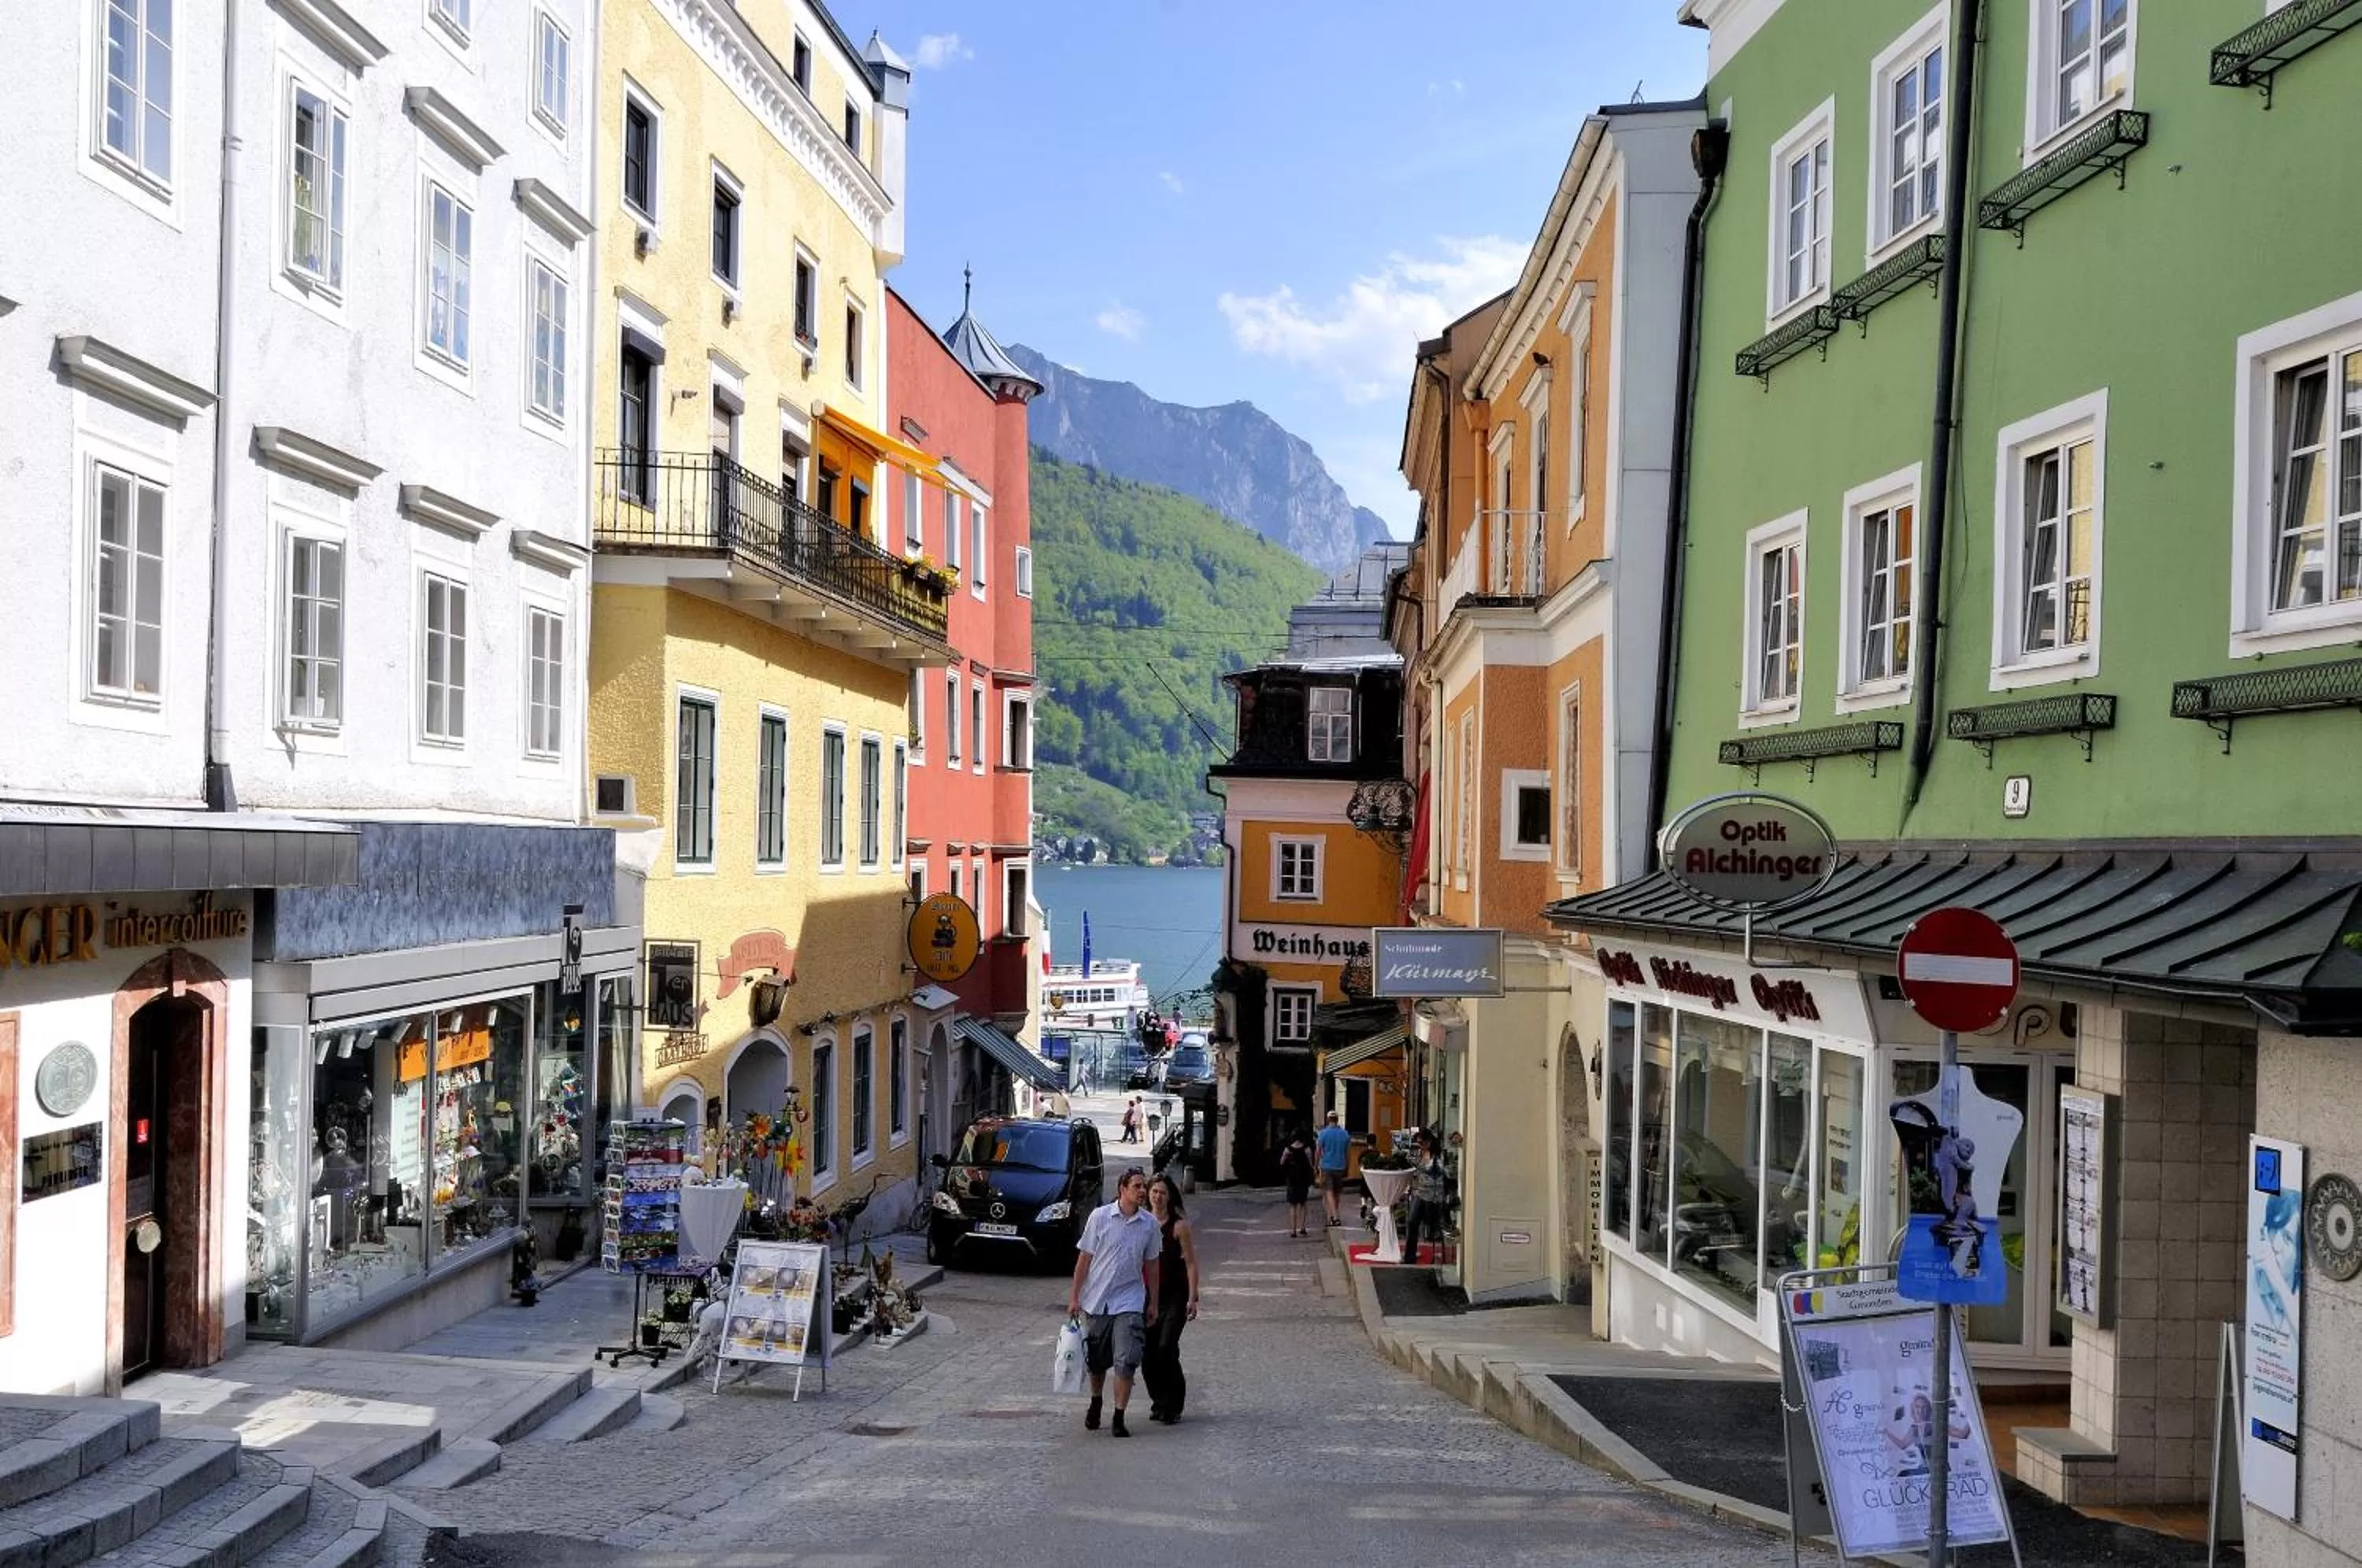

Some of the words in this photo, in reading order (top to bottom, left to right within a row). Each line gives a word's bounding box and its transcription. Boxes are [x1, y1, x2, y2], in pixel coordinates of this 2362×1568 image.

[2012, 780, 2020, 804] 9
[1720, 819, 1786, 846] Optik
[1253, 928, 1372, 960] Weinhaus
[1590, 1159, 1601, 1263] IMMOBILIEN
[1836, 1280, 1900, 1300] Stadtgemeind
